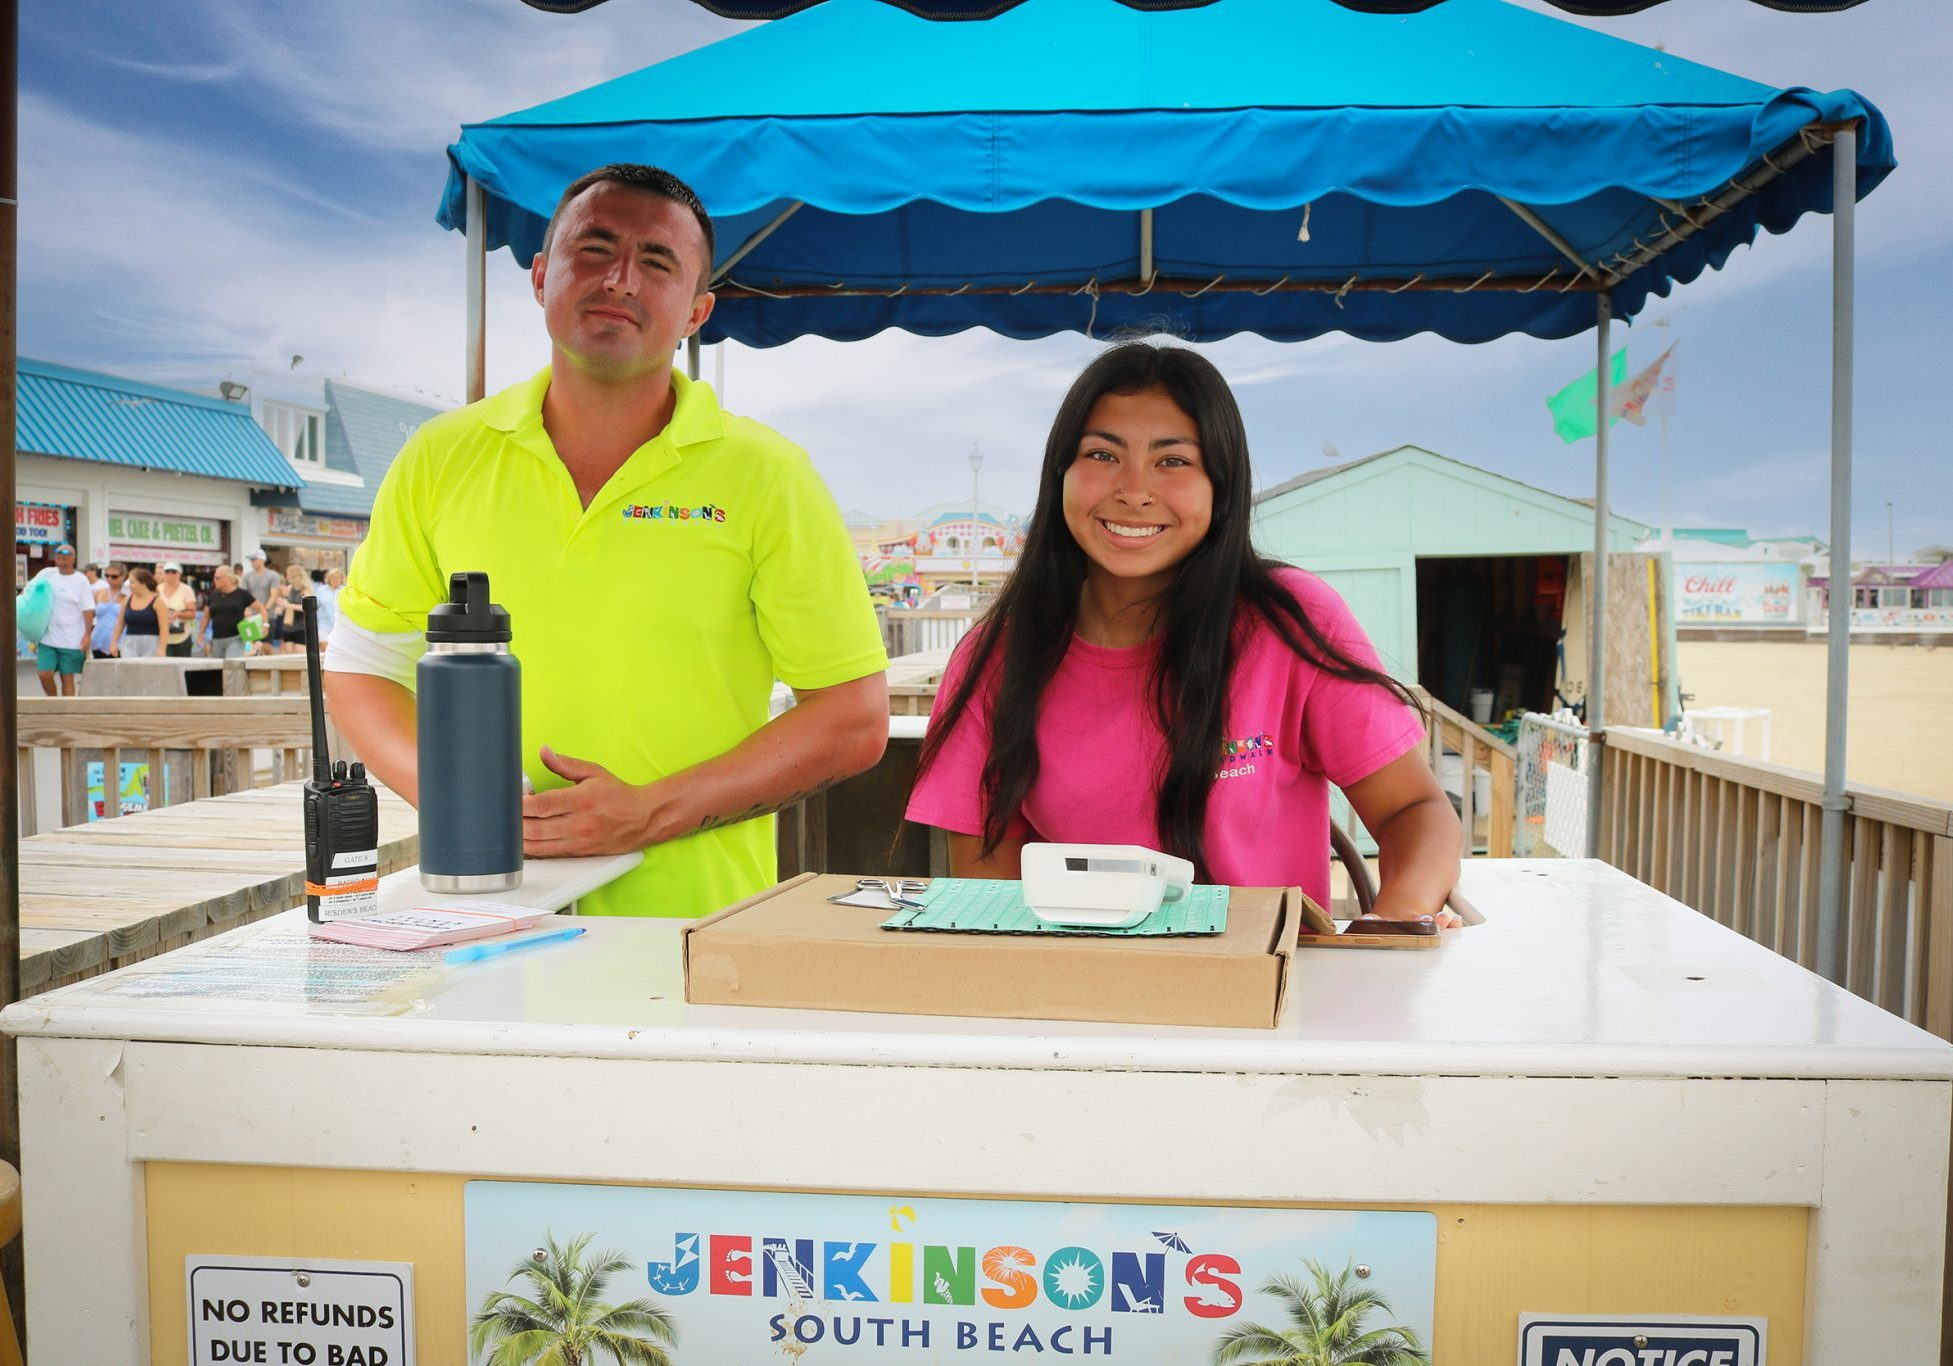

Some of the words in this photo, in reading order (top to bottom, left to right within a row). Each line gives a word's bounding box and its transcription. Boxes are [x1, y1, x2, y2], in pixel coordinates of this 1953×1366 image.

[28, 508, 59, 527] FRIES
[127, 519, 150, 540] CAKE
[1683, 576, 1736, 593] Chill
[1229, 748, 1274, 763] DWALK
[202, 1298, 251, 1323] NO
[261, 1301, 395, 1329] REFUNDS
[769, 1312, 931, 1348] SOUTH
[956, 1320, 1113, 1355] BEACH
[211, 1339, 267, 1363] DUE
[277, 1341, 317, 1365] TO
[328, 1344, 389, 1366] BAD
[1556, 1347, 1735, 1366] NOTICE
